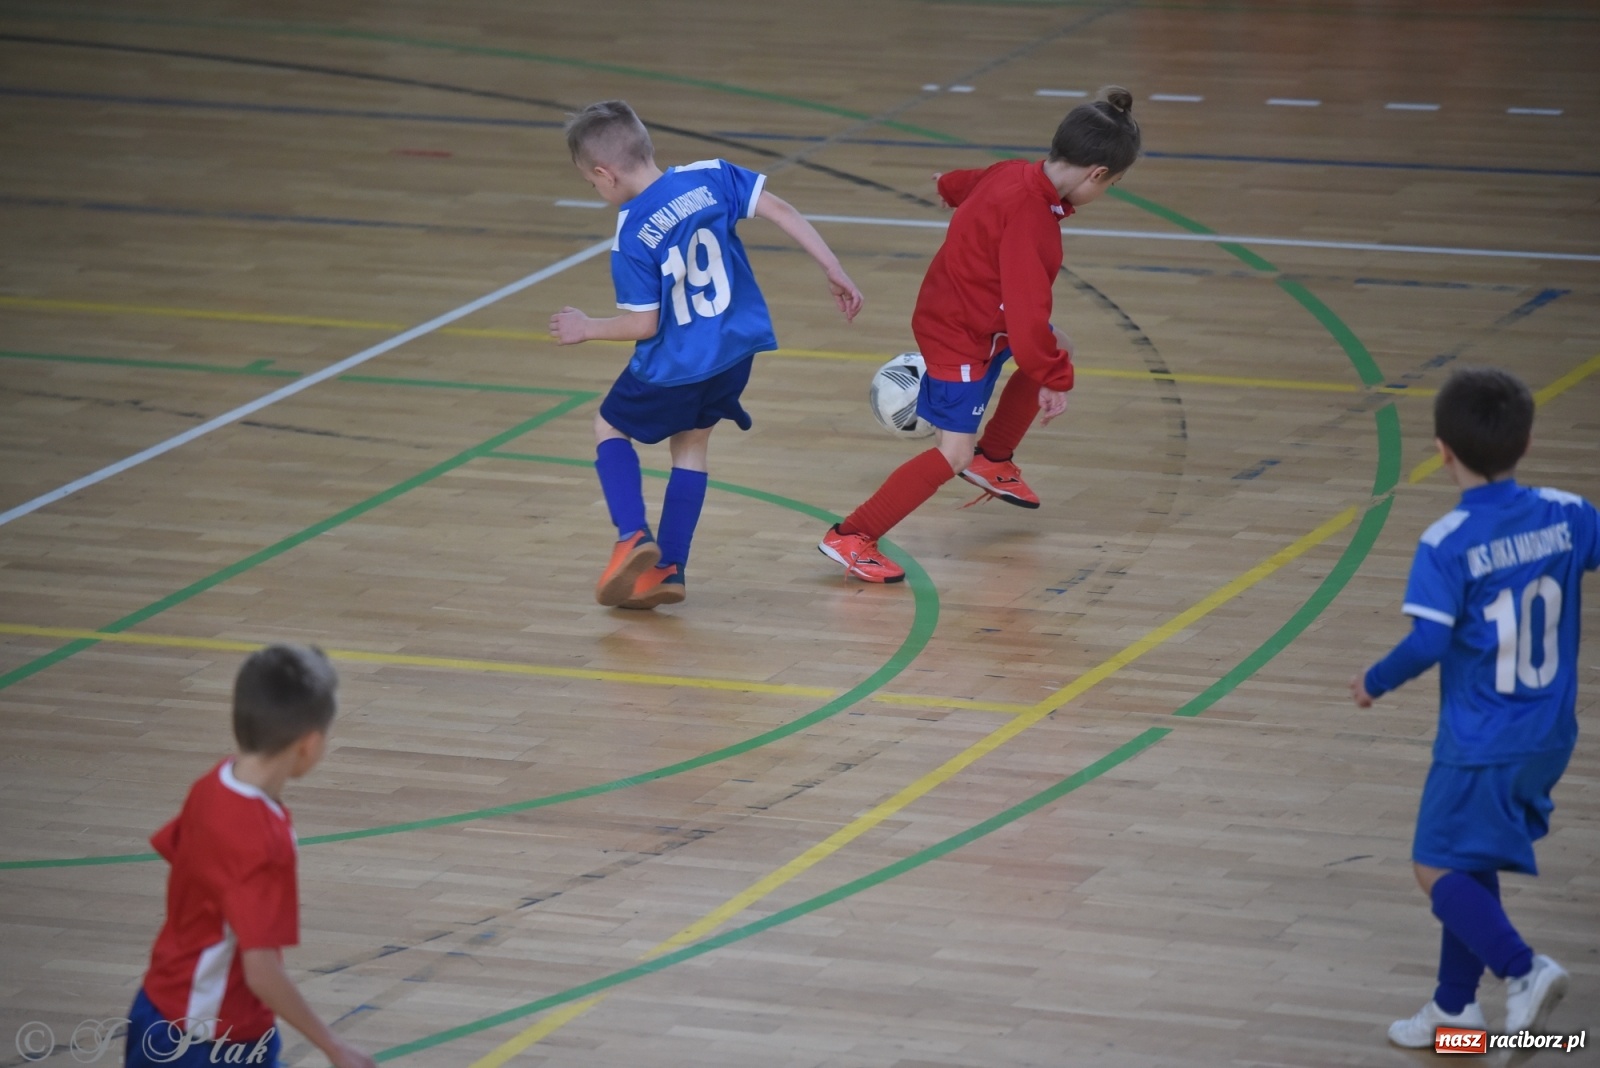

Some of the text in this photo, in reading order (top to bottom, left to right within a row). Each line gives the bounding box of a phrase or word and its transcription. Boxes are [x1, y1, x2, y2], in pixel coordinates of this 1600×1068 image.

[637, 223, 664, 249] UKS
[649, 207, 679, 234] ARKA
[661, 228, 731, 326] 19
[1483, 575, 1562, 694] 10
